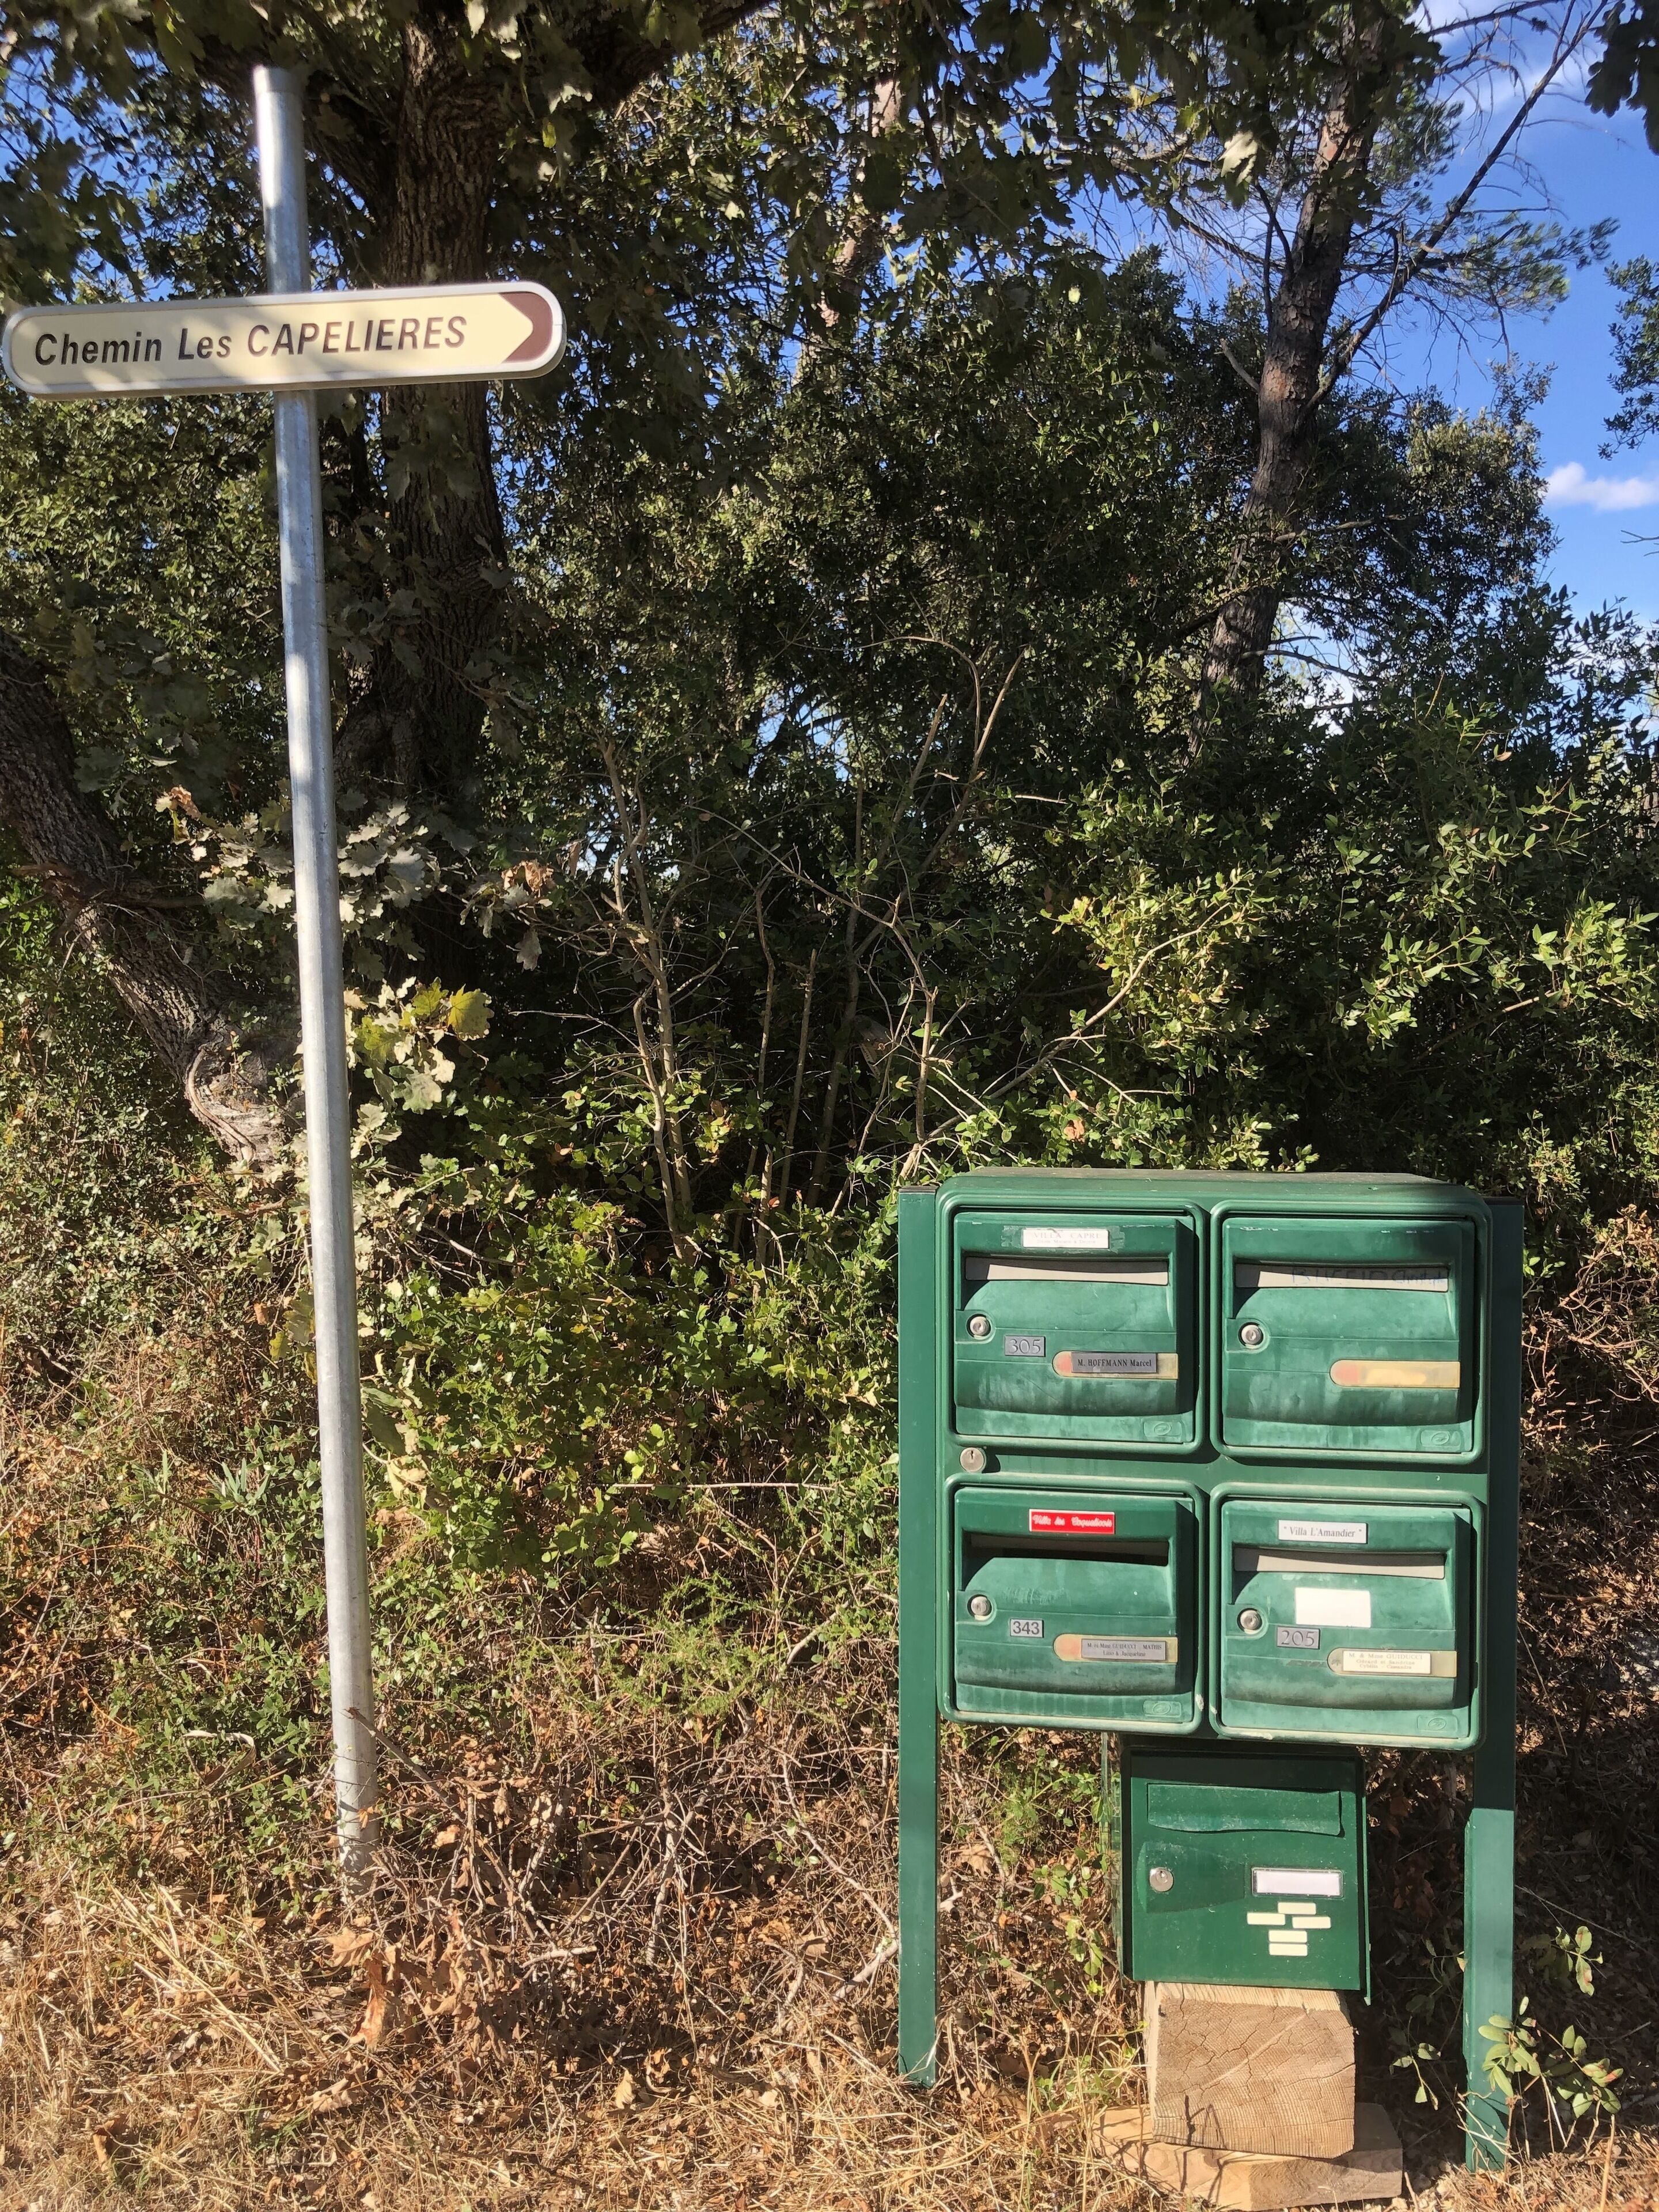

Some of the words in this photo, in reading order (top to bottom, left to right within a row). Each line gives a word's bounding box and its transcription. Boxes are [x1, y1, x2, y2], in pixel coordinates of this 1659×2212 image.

[35, 331, 162, 366] Chemin
[178, 328, 232, 360] Les
[248, 316, 467, 357] CAPELIERES
[1009, 1339, 1041, 1354] 305
[1032, 1514, 1051, 1525] Villa
[1290, 1527, 1306, 1536] Villa
[1310, 1527, 1355, 1537] L'Amandier
[1013, 1621, 1040, 1635] 343
[1281, 1630, 1315, 1646] 205
